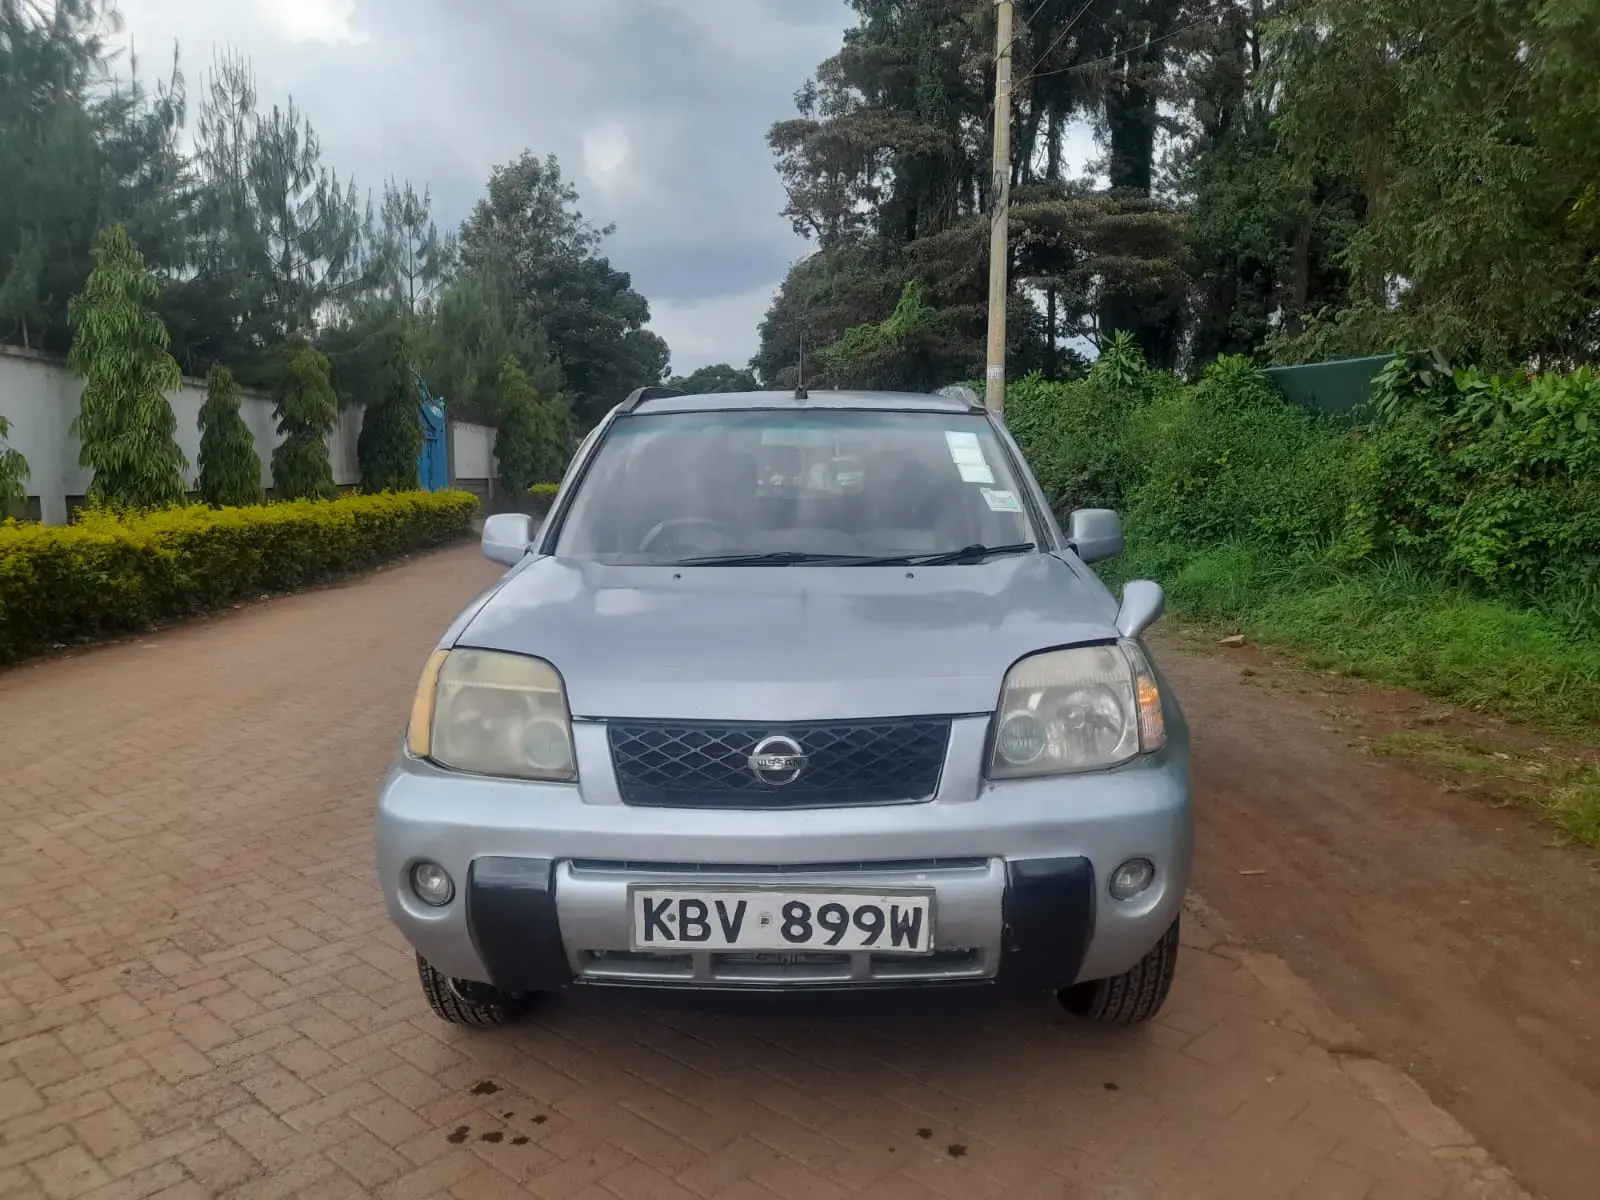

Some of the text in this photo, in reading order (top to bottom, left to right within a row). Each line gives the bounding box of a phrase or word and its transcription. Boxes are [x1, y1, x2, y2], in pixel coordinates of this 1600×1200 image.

[757, 758, 800, 769] NISSAN
[643, 897, 922, 948] KBV 899W
